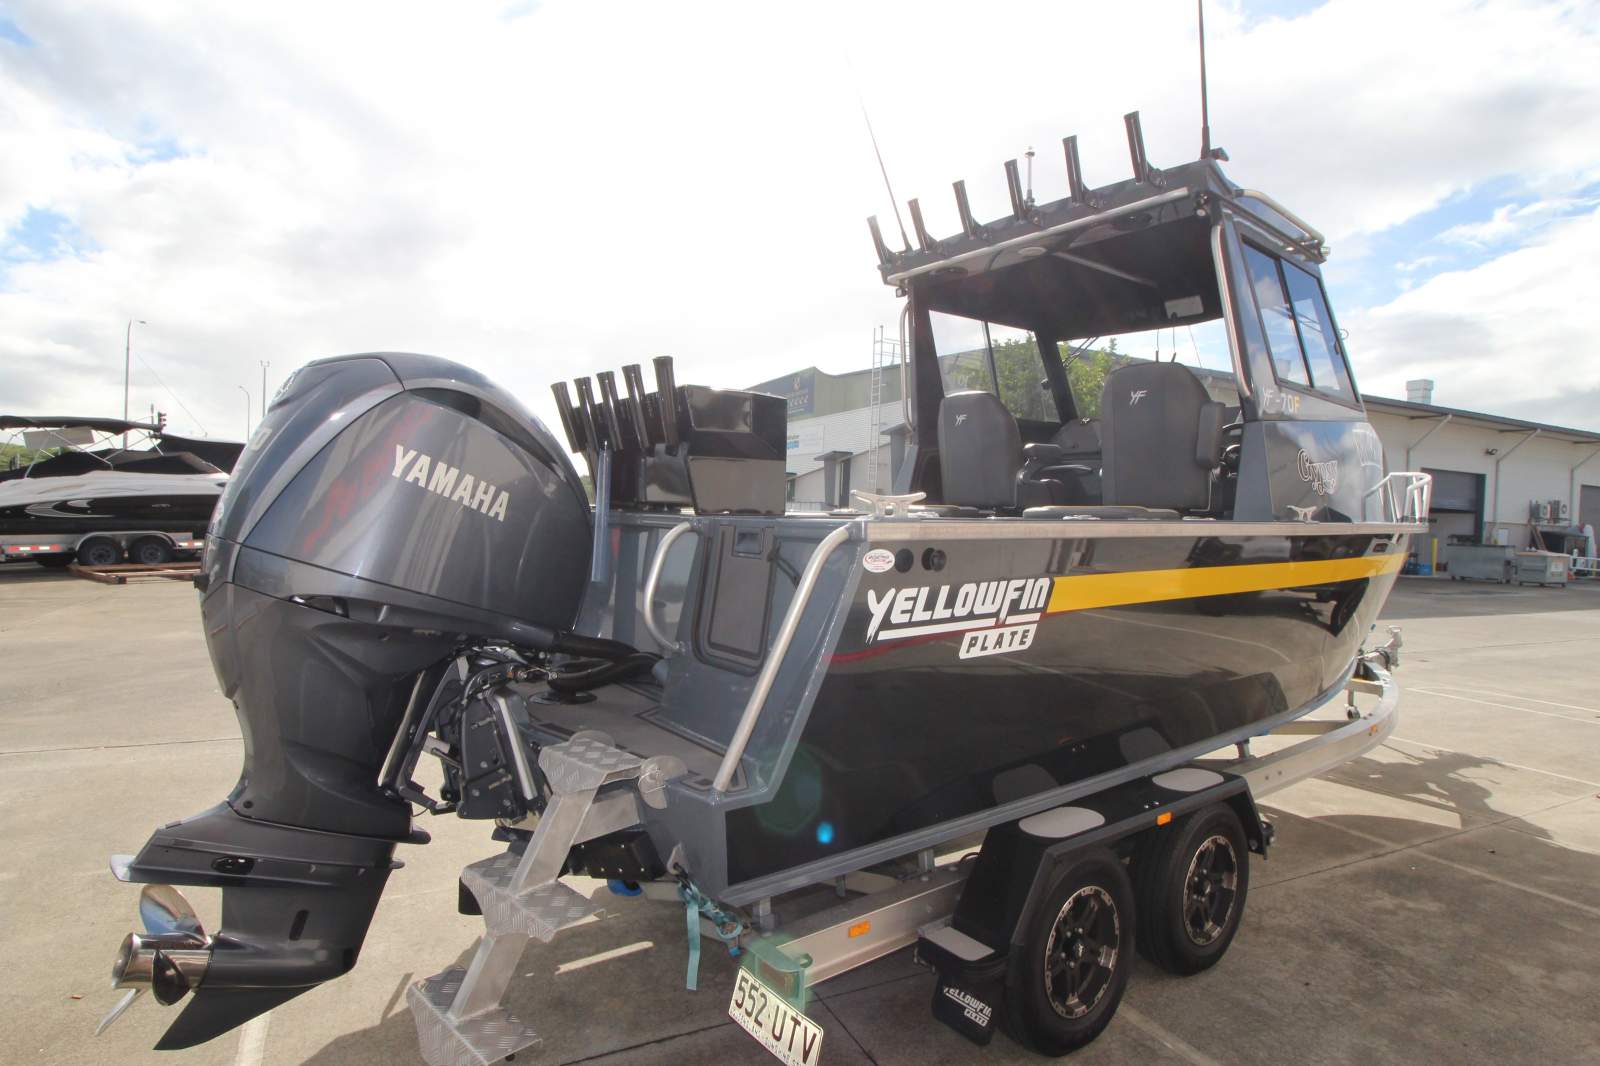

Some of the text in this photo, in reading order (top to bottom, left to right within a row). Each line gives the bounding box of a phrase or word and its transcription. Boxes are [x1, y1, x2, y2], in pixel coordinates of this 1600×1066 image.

[1130, 390, 1148, 405] YF
[392, 444, 509, 522] YAMAHA
[866, 577, 1051, 645] YELLOWFIN
[966, 628, 1030, 654] PLATE
